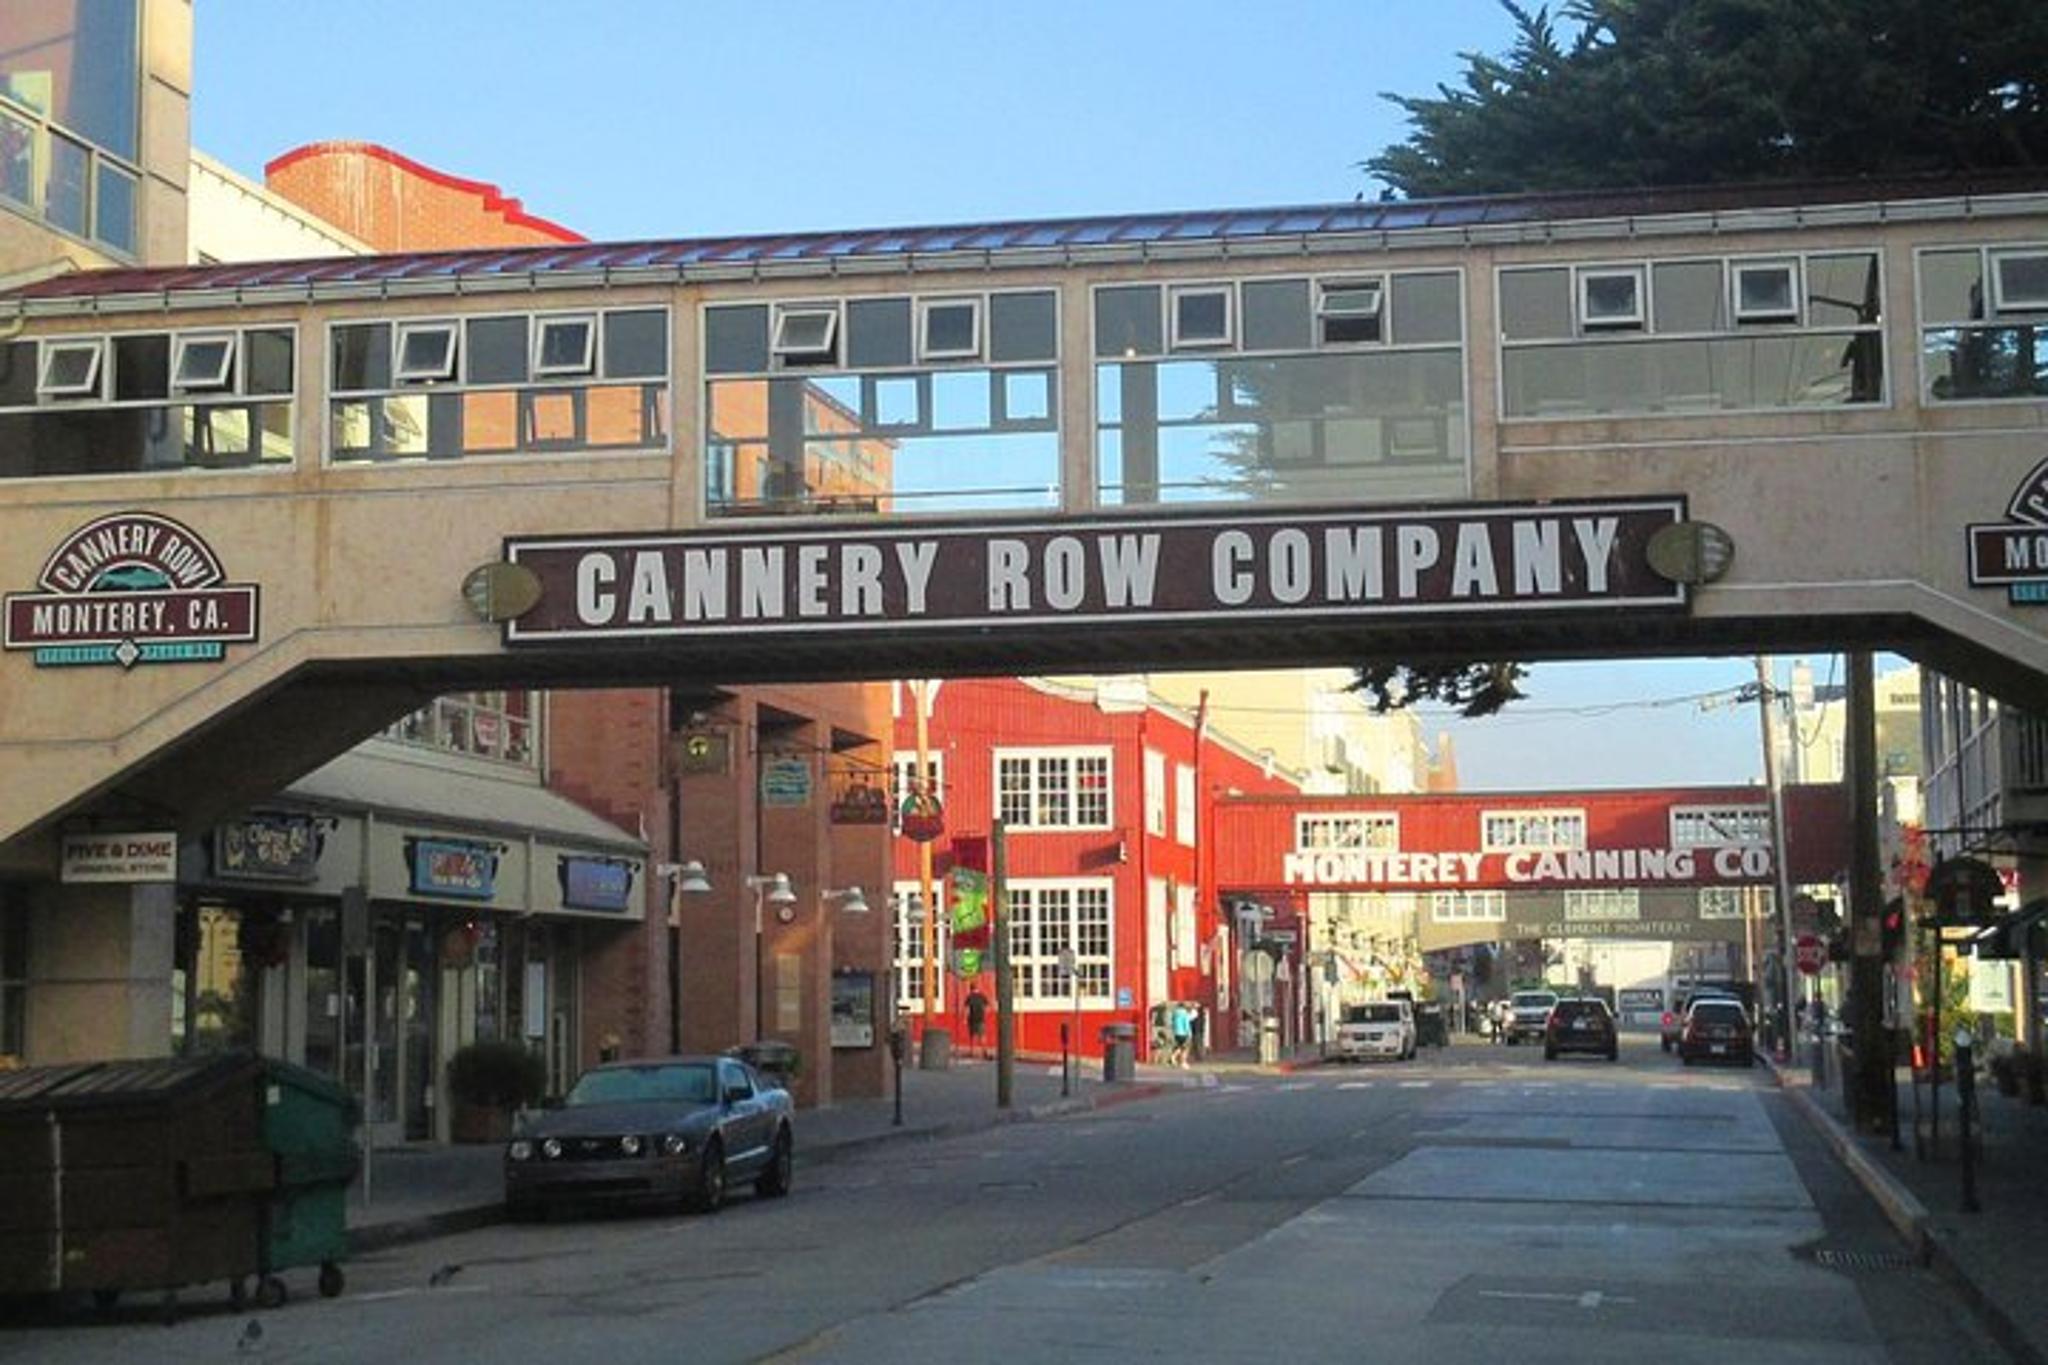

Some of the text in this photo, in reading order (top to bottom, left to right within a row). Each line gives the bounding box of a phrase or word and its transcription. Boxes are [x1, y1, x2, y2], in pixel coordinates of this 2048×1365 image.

[55, 525, 208, 590] CANNERY ROW
[576, 516, 1618, 626] CANNERY ROW COMPANY
[33, 599, 228, 636] MONTEREY, CA.
[1283, 851, 1483, 884] MONTEREY
[1505, 850, 1696, 882] CANNING
